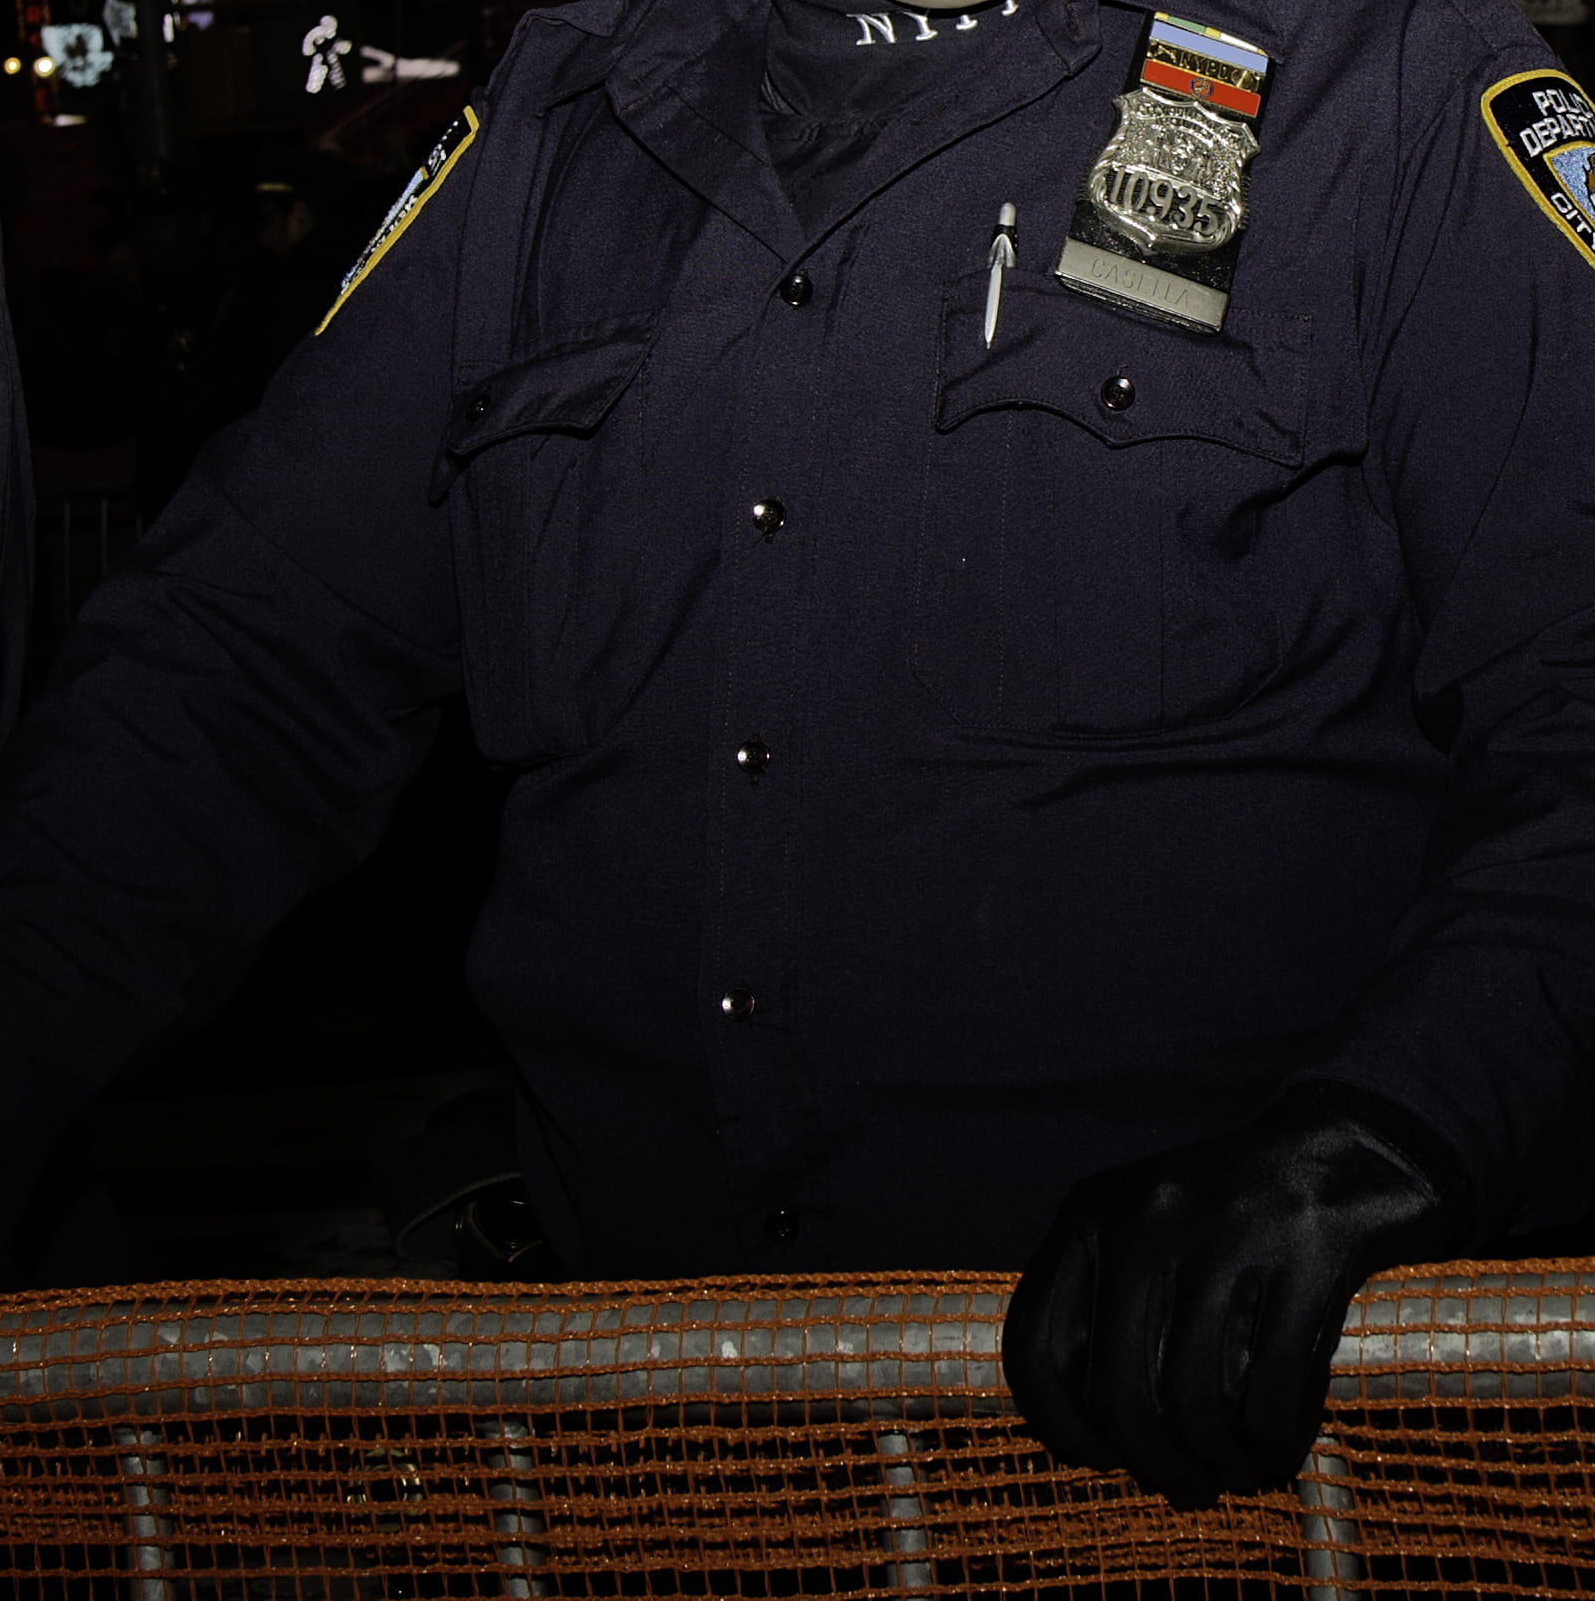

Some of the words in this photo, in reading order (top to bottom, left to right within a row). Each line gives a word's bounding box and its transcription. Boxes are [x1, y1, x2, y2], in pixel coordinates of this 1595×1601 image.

[1178, 50, 1232, 82] NYPD
[1109, 165, 1220, 238] 10935
[1091, 256, 1193, 309] CASELLA
